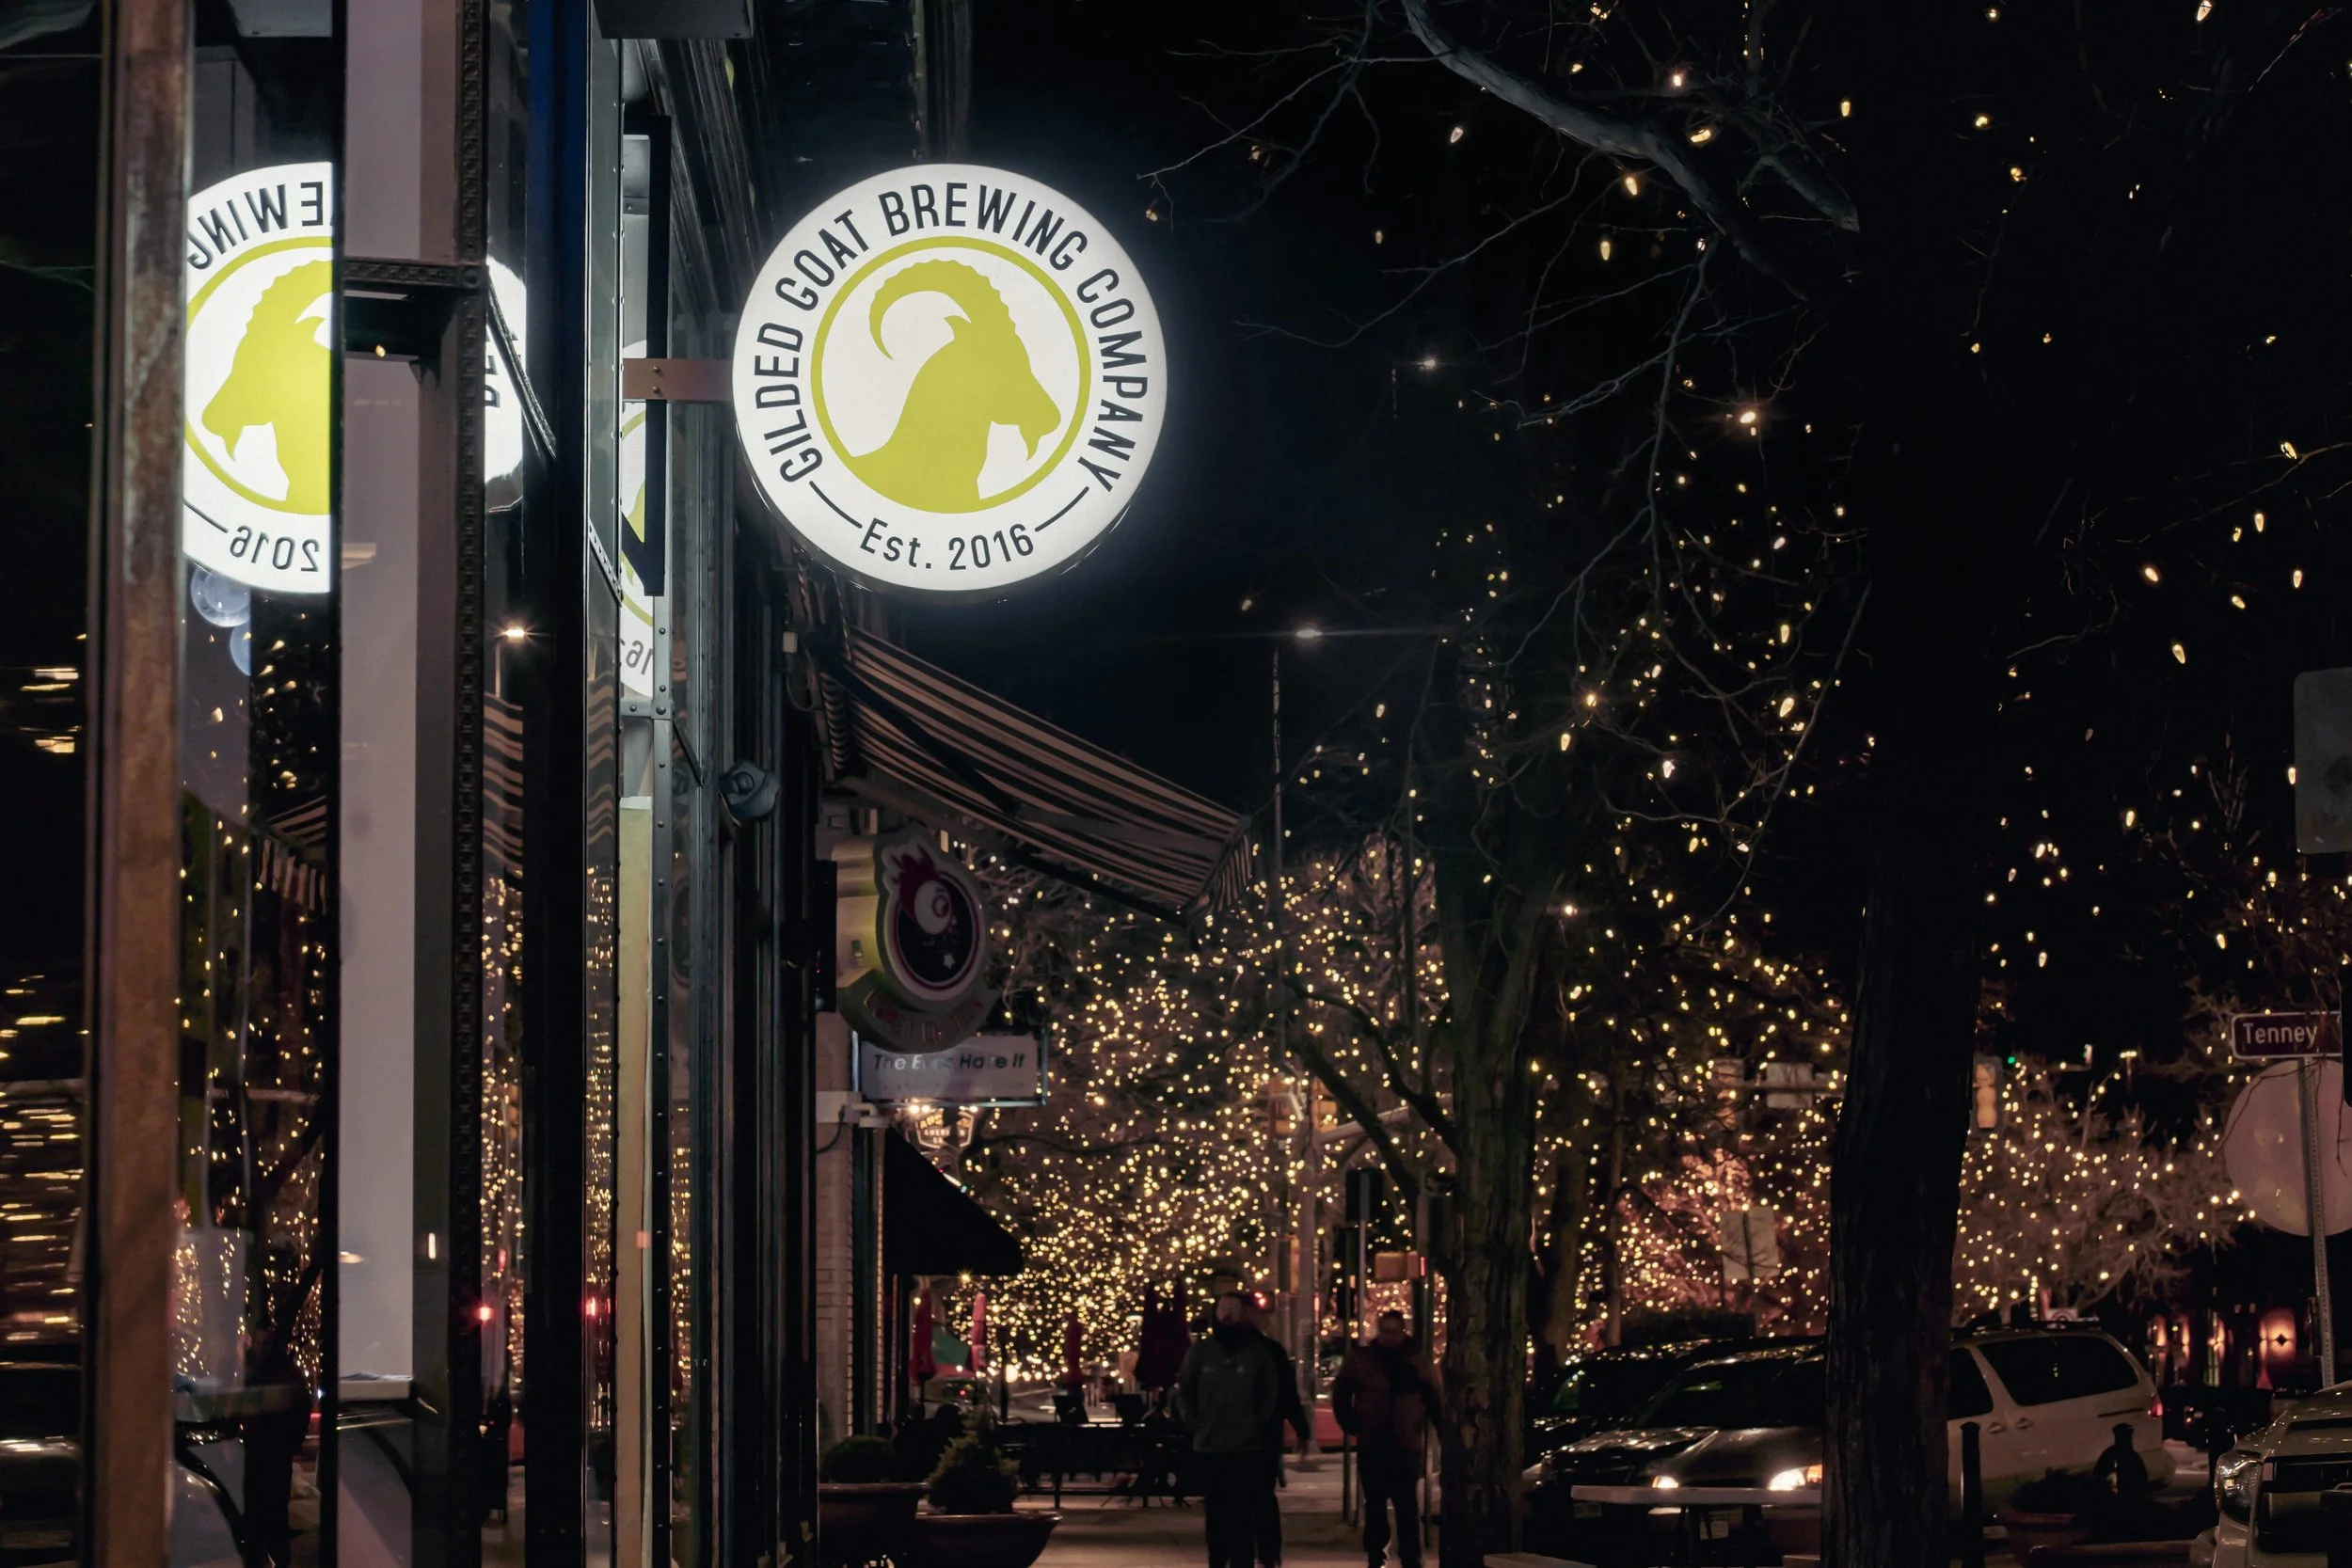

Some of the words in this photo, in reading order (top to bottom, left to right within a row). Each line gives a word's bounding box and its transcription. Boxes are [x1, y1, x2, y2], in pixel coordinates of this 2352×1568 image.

[774, 209, 870, 311] GOAT
[878, 182, 1089, 271] BREWING
[755, 322, 823, 483] GILDED
[1075, 268, 1149, 493] COMPANY
[860, 517, 932, 570] Est.
[948, 523, 1034, 571] 2016
[874, 1054, 906, 1070] The
[1012, 1053, 1025, 1069] It
[2242, 1022, 2318, 1050] Tenney
